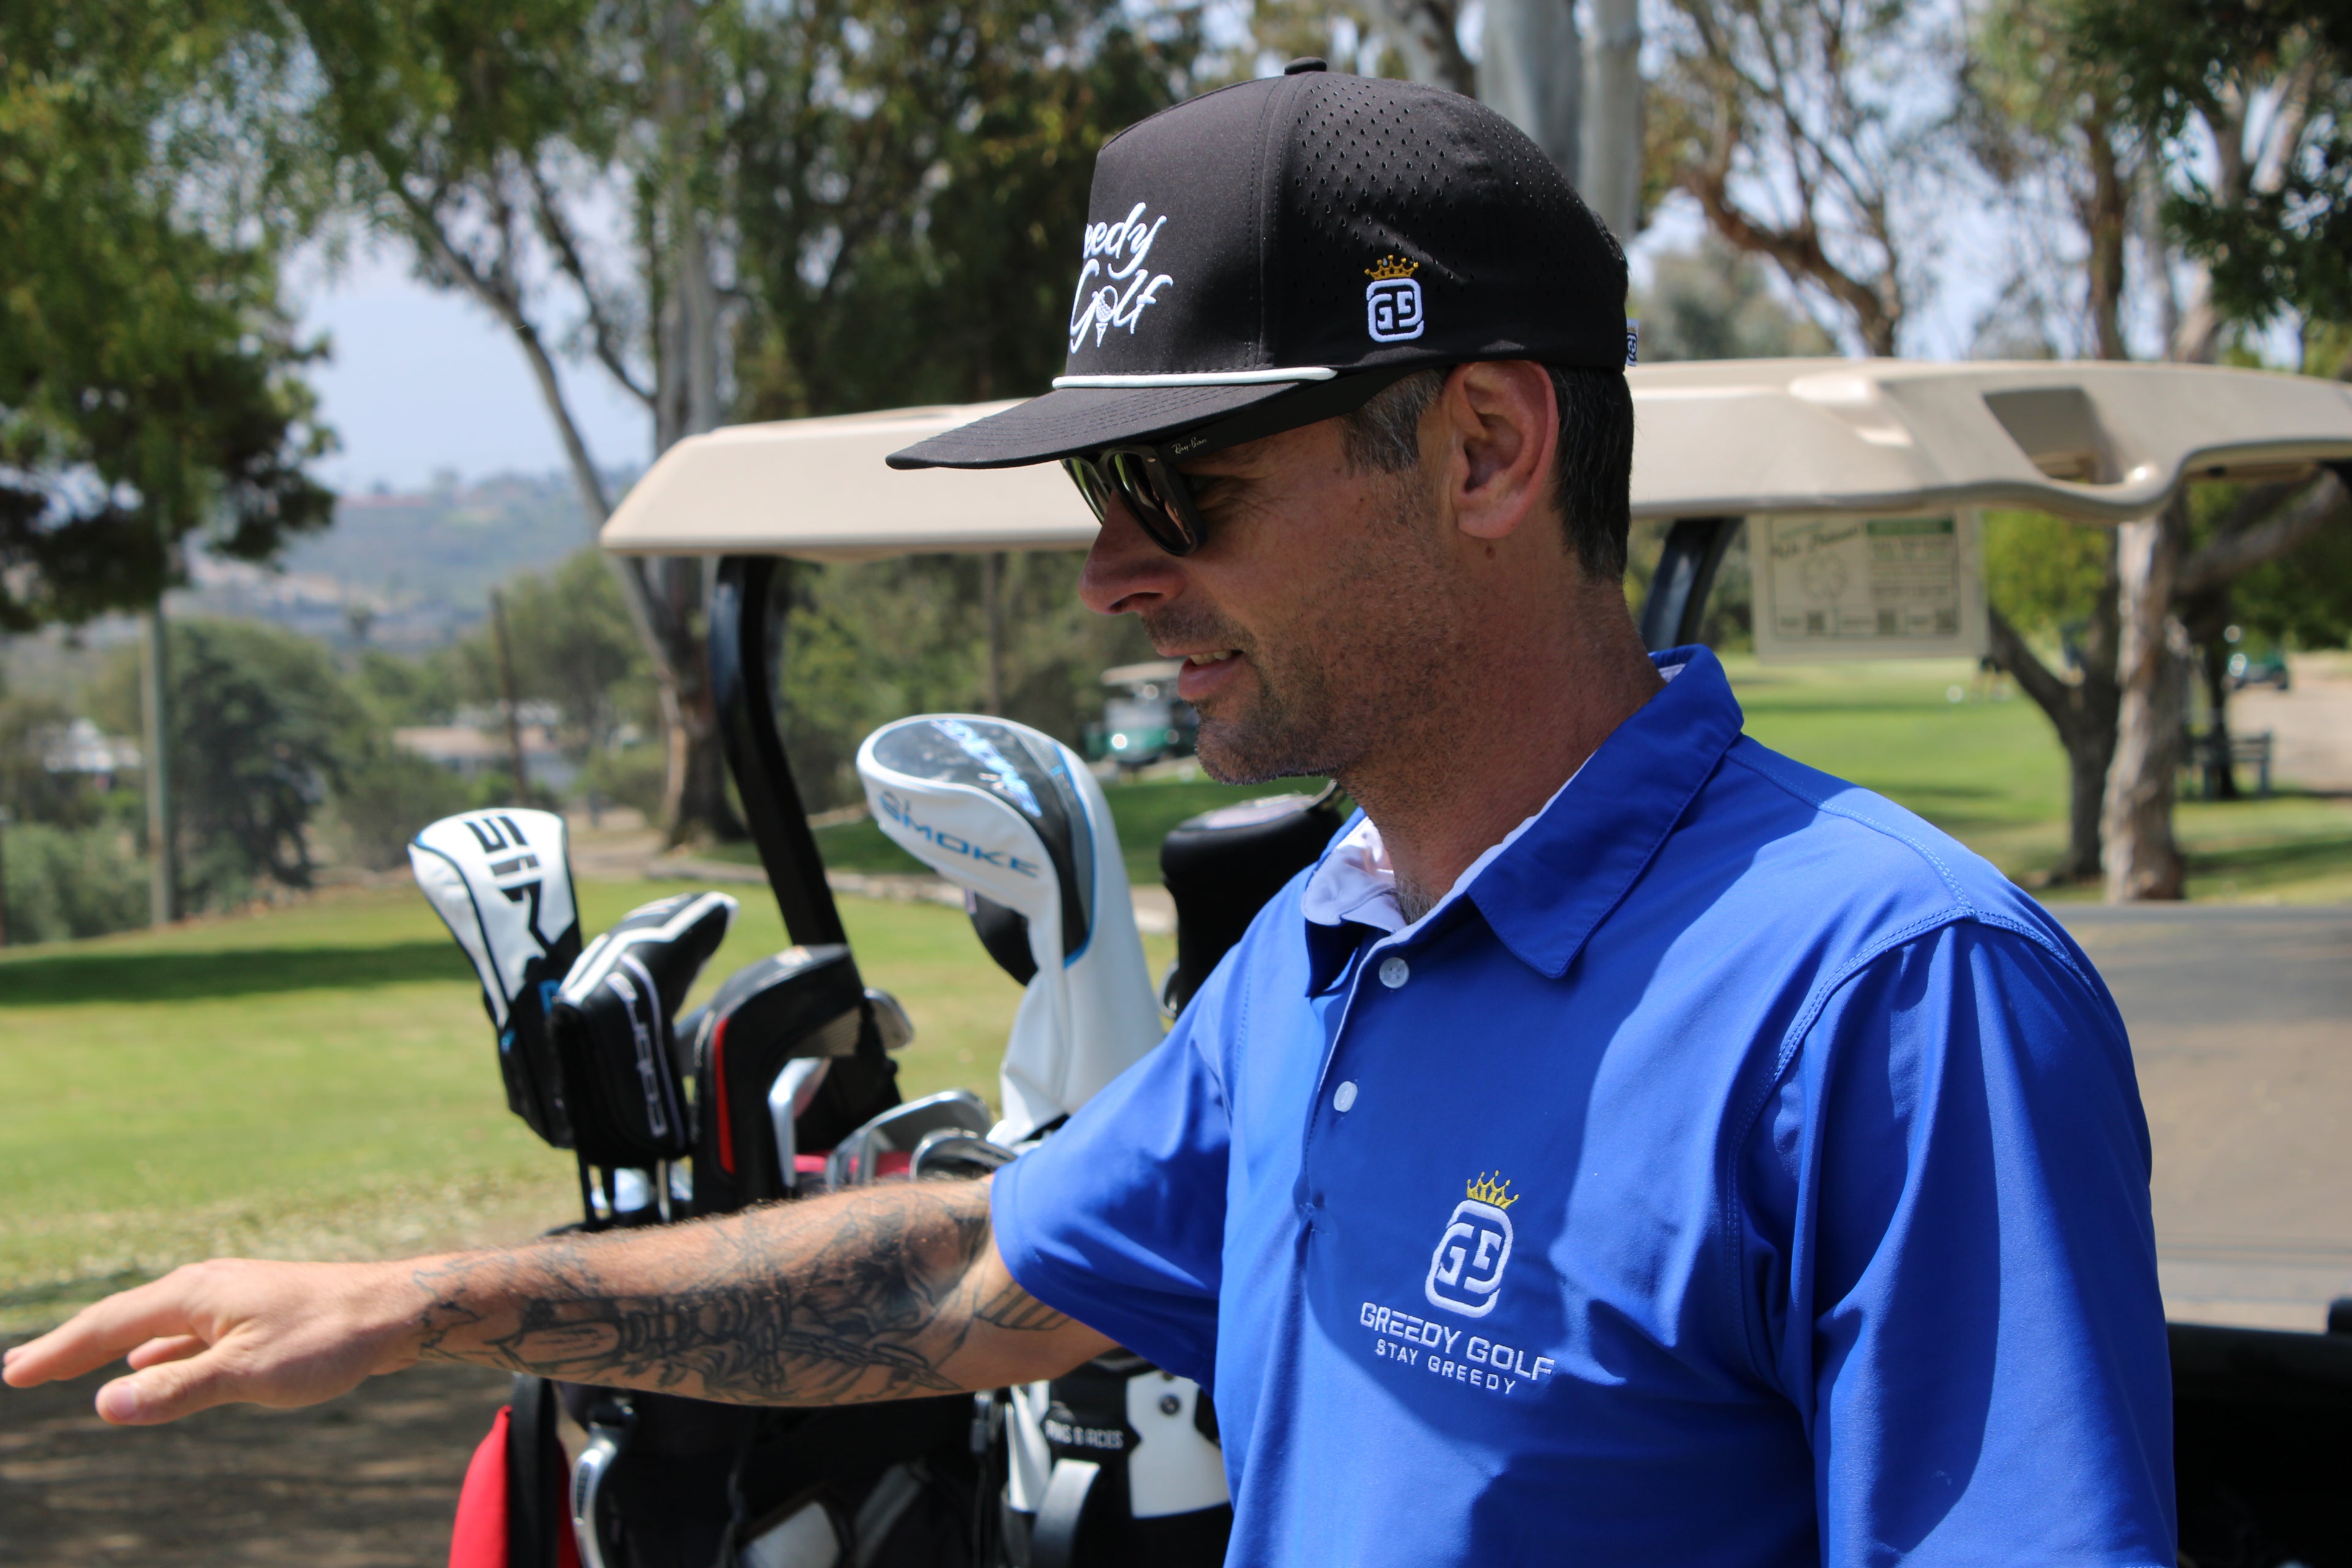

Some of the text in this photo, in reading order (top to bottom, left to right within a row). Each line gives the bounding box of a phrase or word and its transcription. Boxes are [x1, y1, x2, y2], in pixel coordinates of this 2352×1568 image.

[1069, 258, 1174, 354] Golf
[1171, 437, 1207, 454] Ray-Ban
[878, 795, 1039, 878] SMOKE
[1360, 1302, 1555, 1381] GREEDY GOLF
[1374, 1338, 1516, 1395] STAY GREEDY
